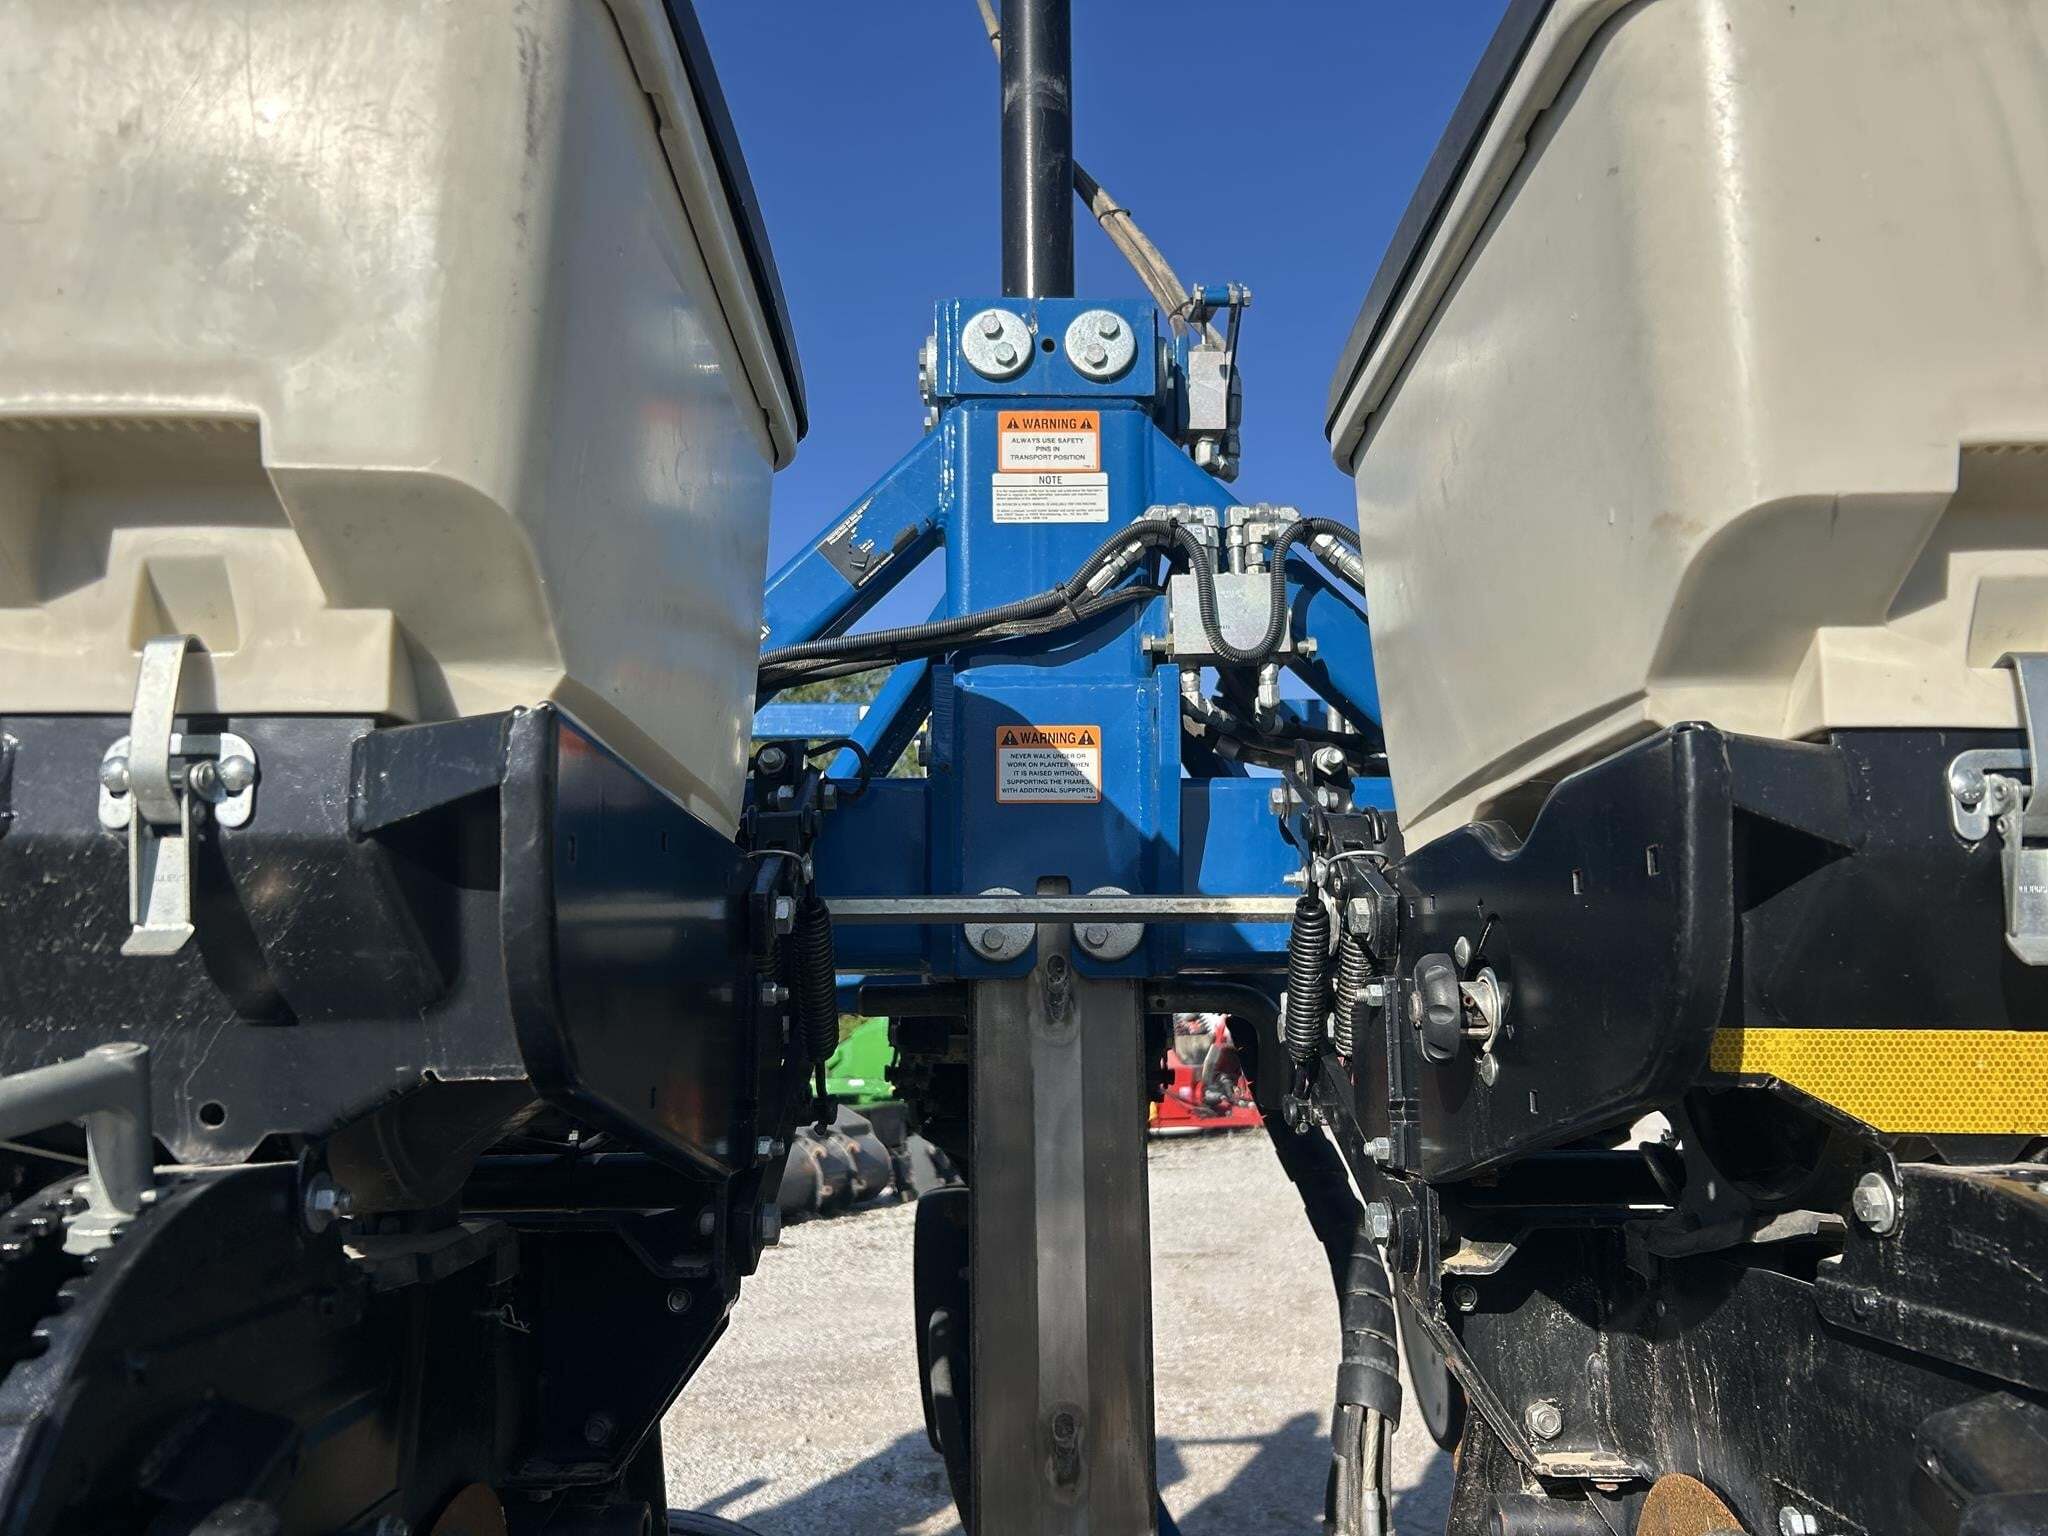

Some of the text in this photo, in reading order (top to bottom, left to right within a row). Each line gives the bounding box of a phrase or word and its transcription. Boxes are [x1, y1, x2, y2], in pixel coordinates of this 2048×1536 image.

[1022, 418, 1077, 429] WARNING
[1038, 475, 1063, 485] NOTE
[1020, 732, 1076, 745] WARNING
